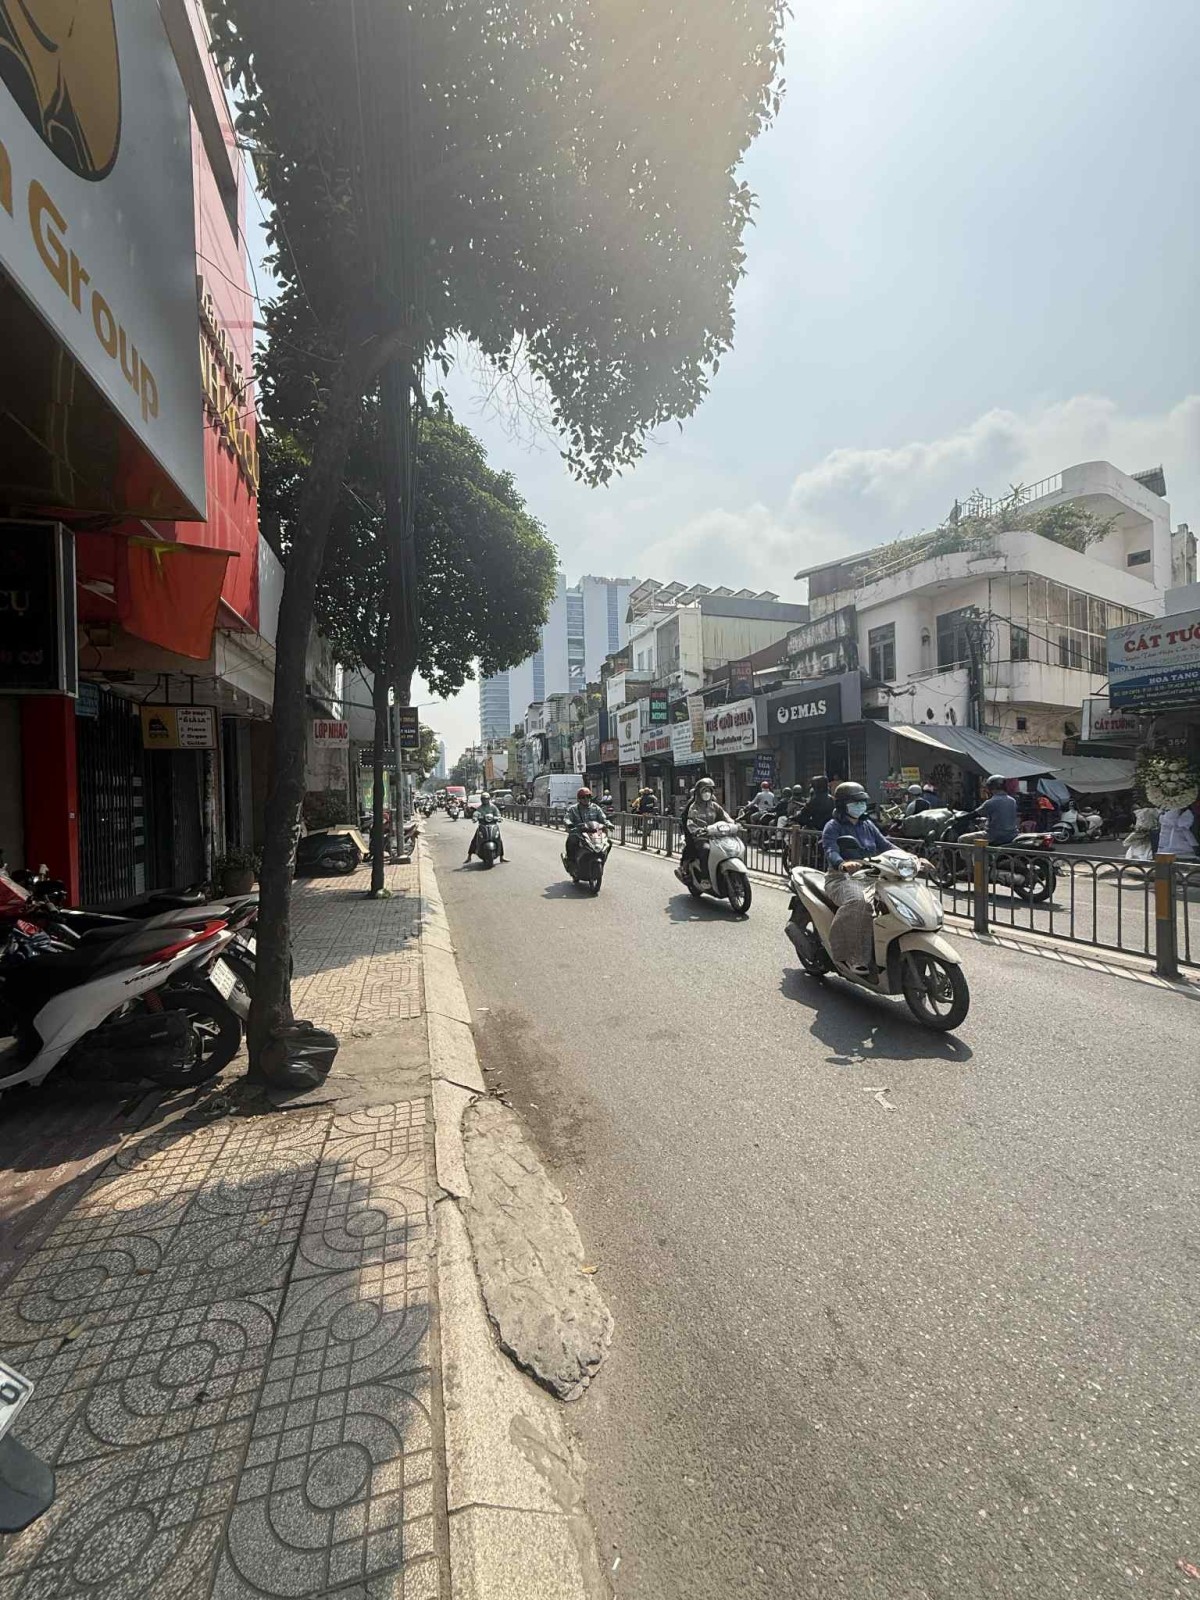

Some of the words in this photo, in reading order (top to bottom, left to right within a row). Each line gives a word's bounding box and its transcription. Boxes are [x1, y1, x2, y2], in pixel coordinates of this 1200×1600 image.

[28, 179, 160, 424] Group
[1124, 634, 1162, 653] CÁT
[1171, 671, 1199, 681] TANG
[790, 699, 827, 720] EMAS
